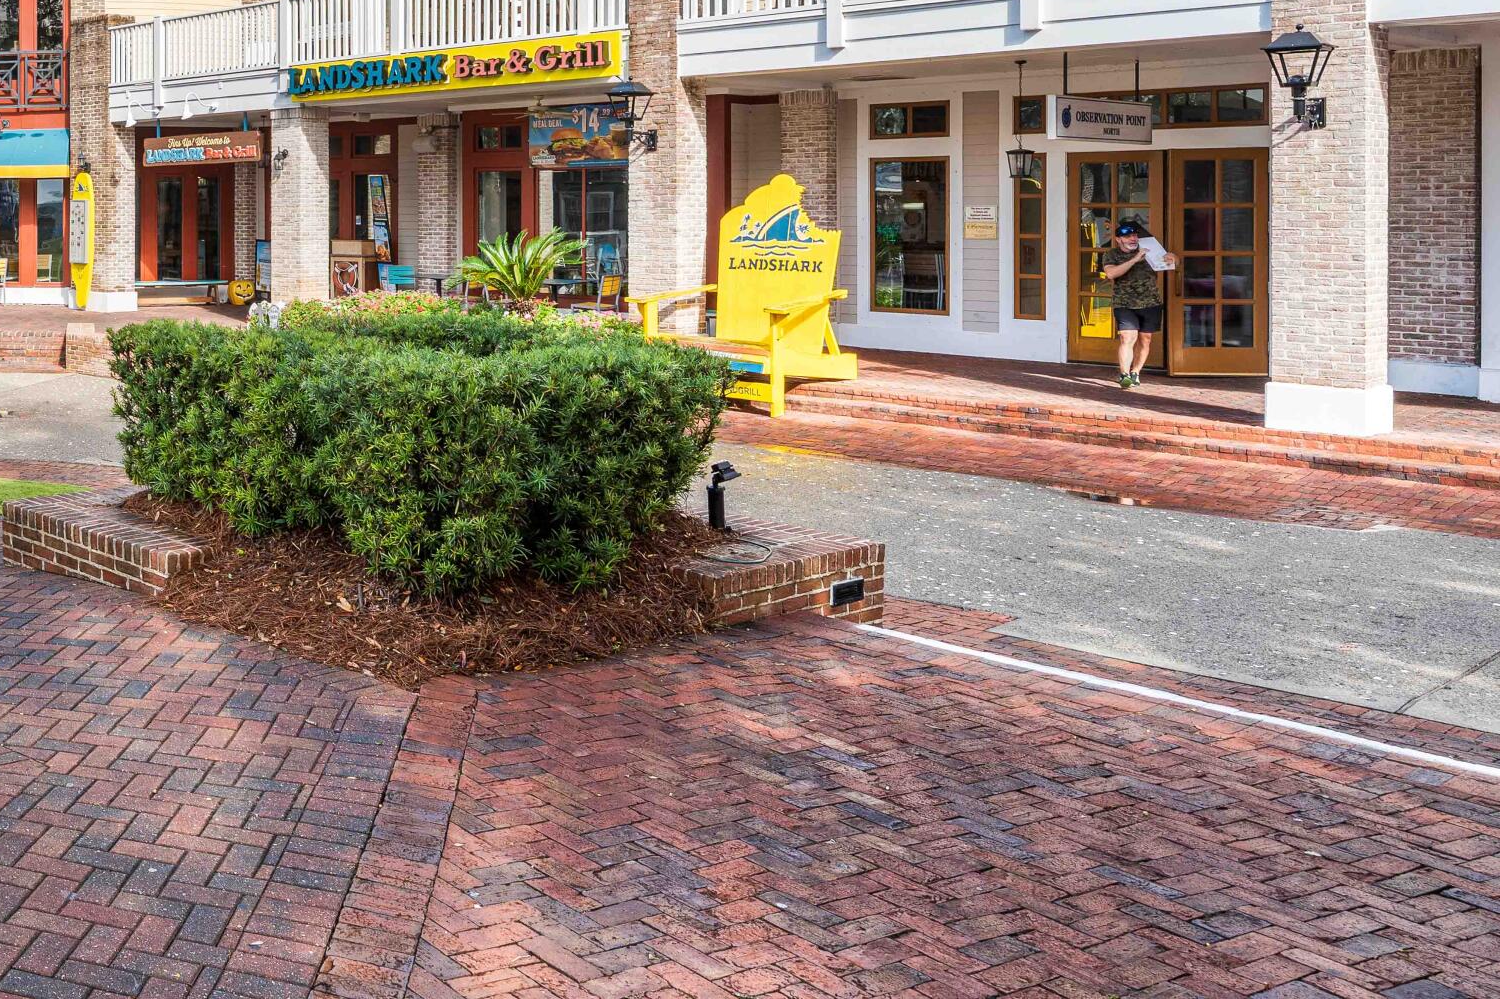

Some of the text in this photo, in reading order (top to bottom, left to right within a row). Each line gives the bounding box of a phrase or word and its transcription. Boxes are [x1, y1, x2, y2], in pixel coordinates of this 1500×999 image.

[288, 40, 606, 95] LANDSHARK Bar & Grill
[532, 119, 563, 129] MEAL DEAL
[1076, 111, 1146, 127] OBSERVATION POINT
[1103, 127, 1120, 136] NORTH
[195, 136, 223, 147] Welcome
[223, 135, 231, 145] to
[146, 144, 257, 163] LANDSHARK Bar & Grill
[728, 257, 823, 273] LANDSHARK
